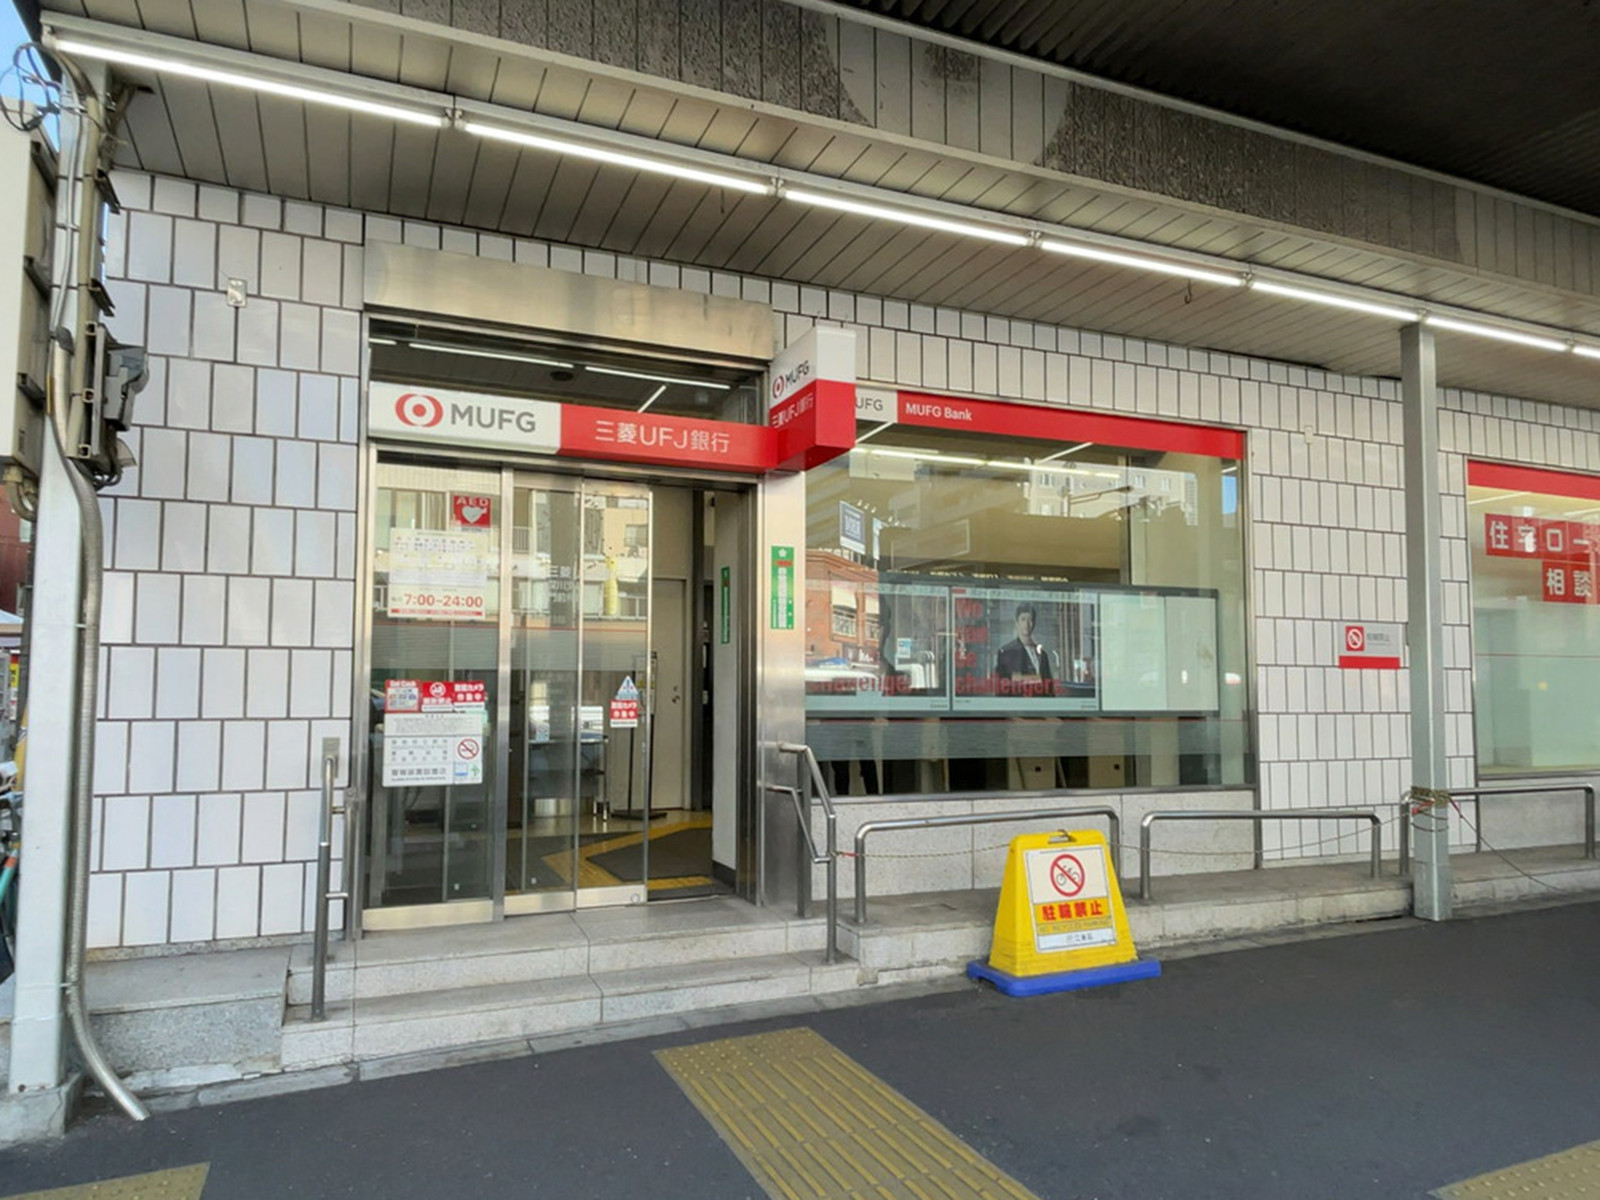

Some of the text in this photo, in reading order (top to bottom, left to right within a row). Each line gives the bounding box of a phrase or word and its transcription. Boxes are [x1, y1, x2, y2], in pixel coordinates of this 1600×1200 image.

[785, 360, 809, 388] MUFG
[450, 403, 536, 433] MUFG
[905, 402, 973, 421] MUFG Bank
[595, 419, 731, 454] 三菱UFJ銀行
[455, 496, 489, 508] AED
